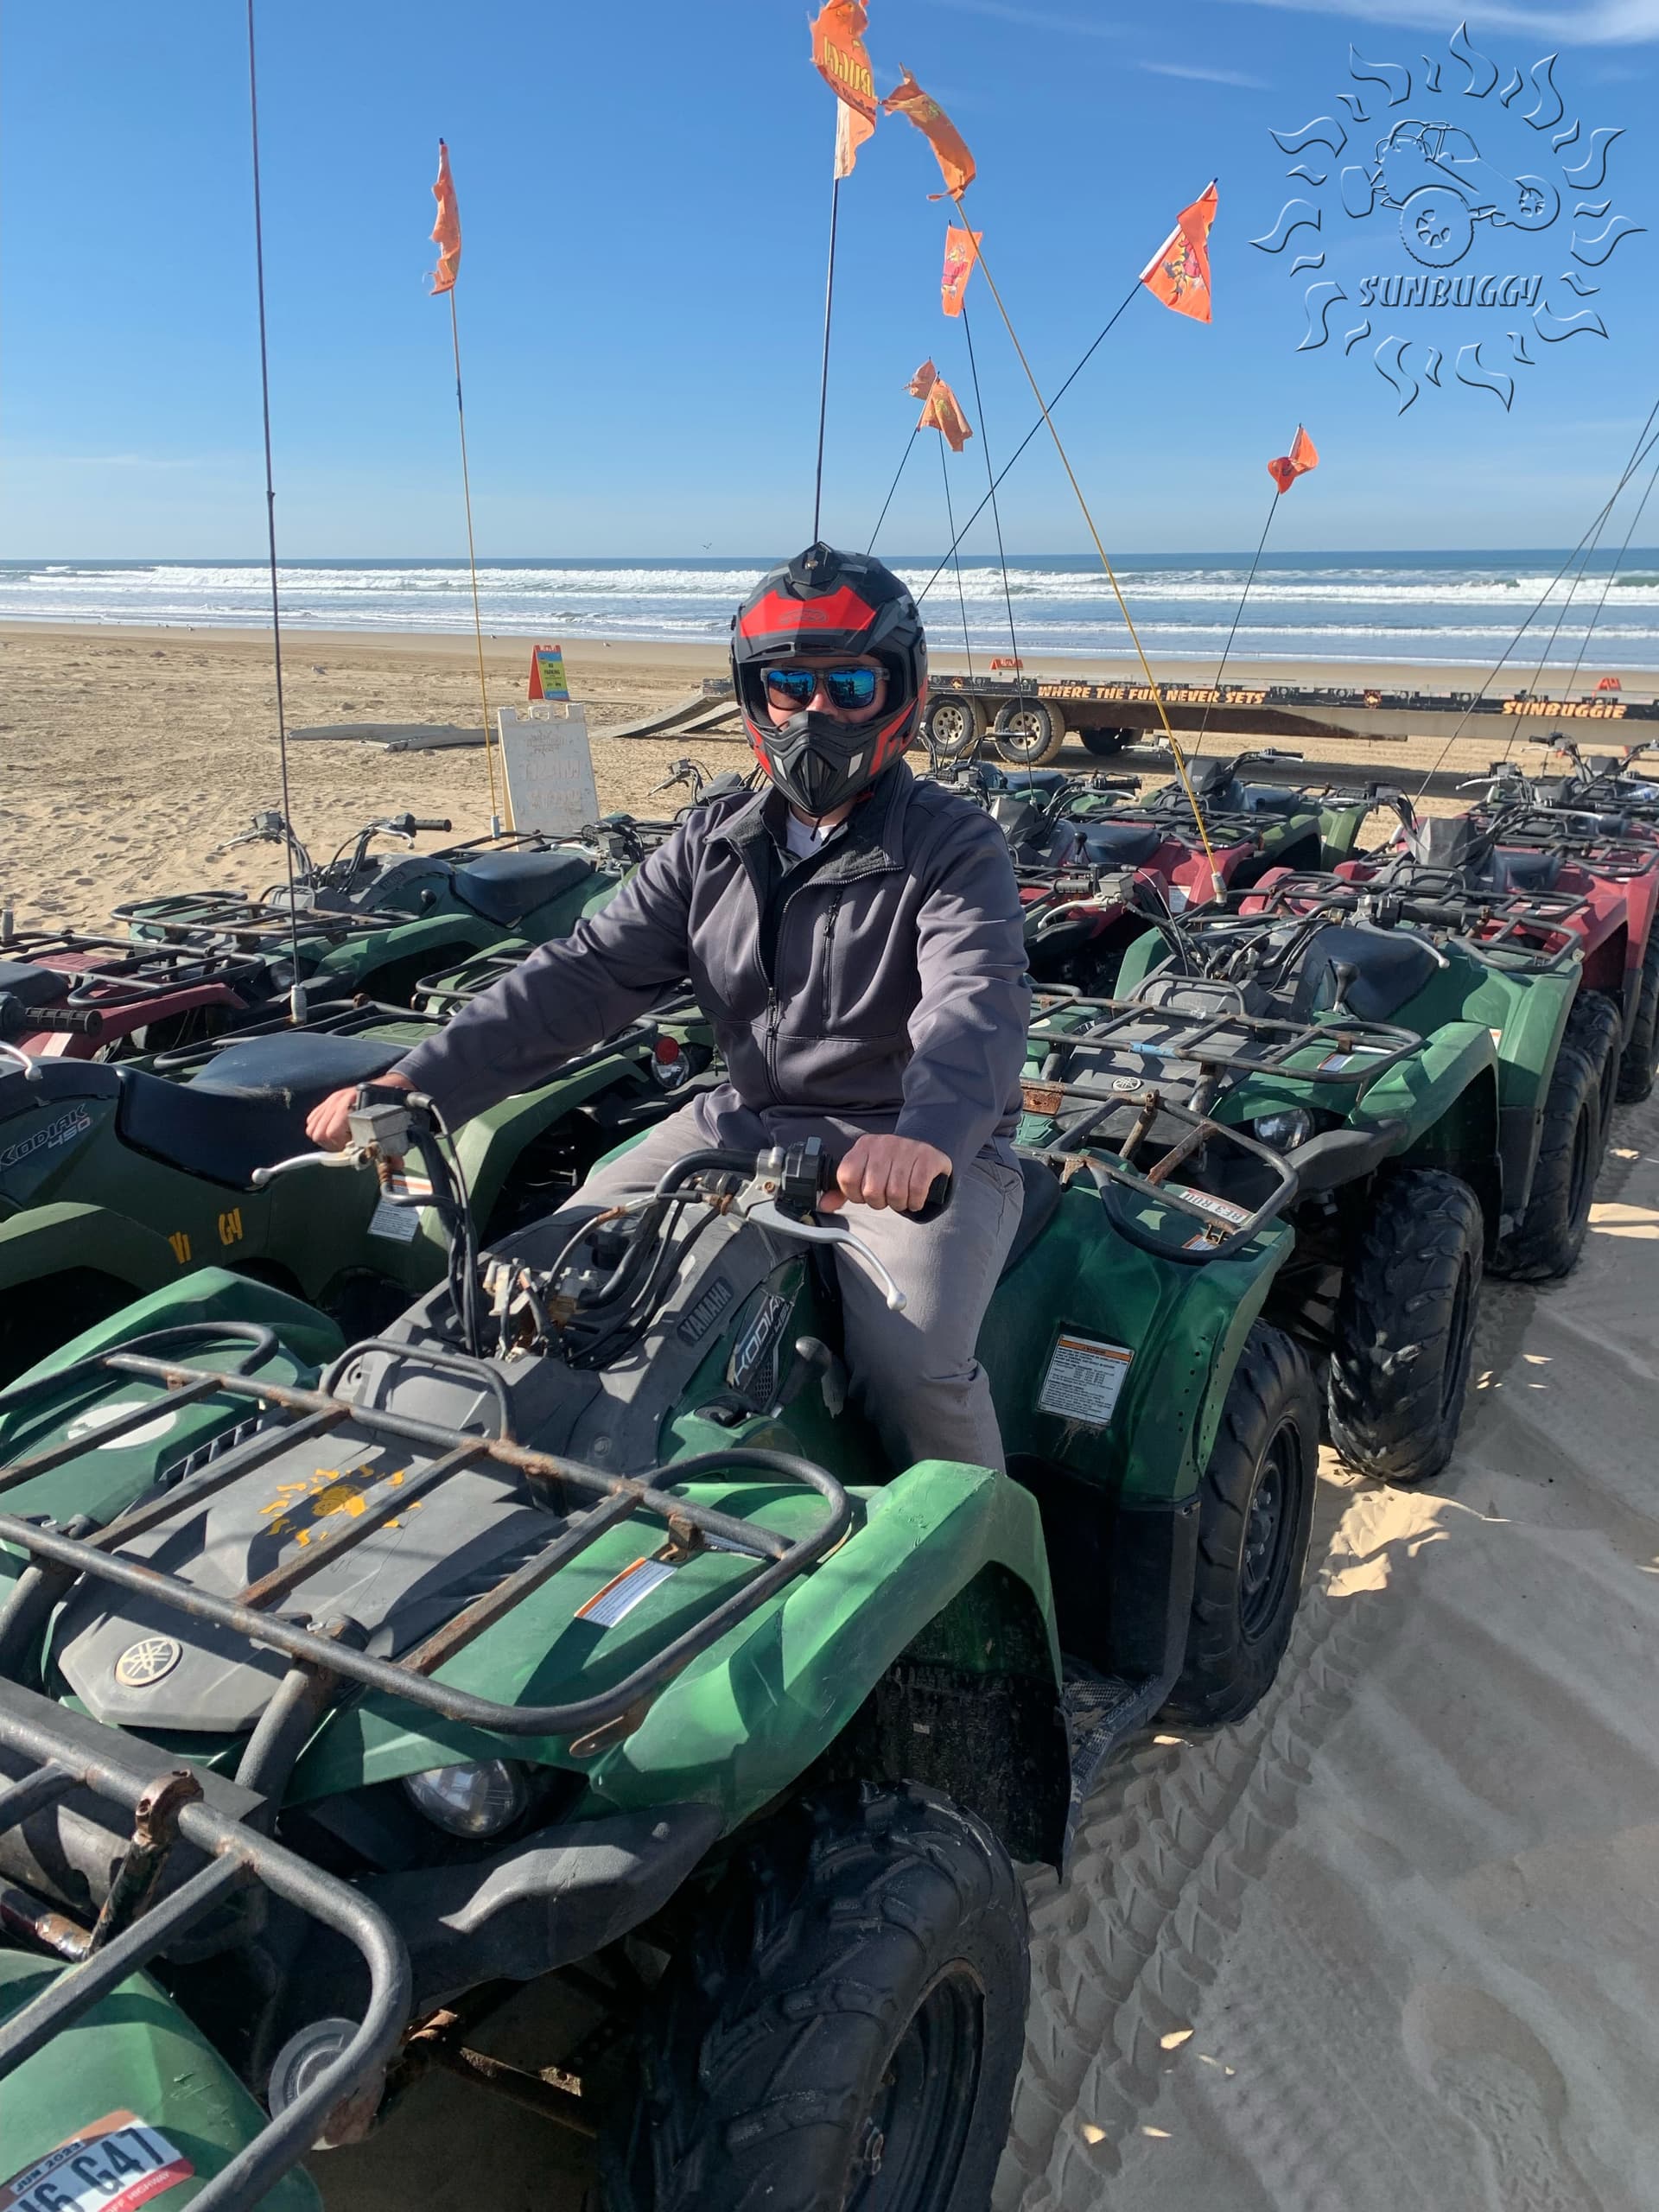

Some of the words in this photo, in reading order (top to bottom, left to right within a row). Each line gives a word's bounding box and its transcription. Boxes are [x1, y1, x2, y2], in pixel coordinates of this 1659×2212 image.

[1038, 684, 1091, 699] WHERE
[1096, 687, 1124, 699] THE
[1128, 689, 1162, 701] FUN
[1166, 690, 1219, 703] NEVER
[1225, 691, 1266, 704] SETS
[1502, 701, 1628, 719] SUNBUGGIE
[0, 1102, 88, 1166] KODIAK
[48, 1116, 91, 1149] 450
[681, 1280, 732, 1340] YAMAHA
[71, 2126, 165, 2196] G47
[16, 2170, 41, 2192] JUN
[127, 2170, 170, 2202] HIGHWAY
